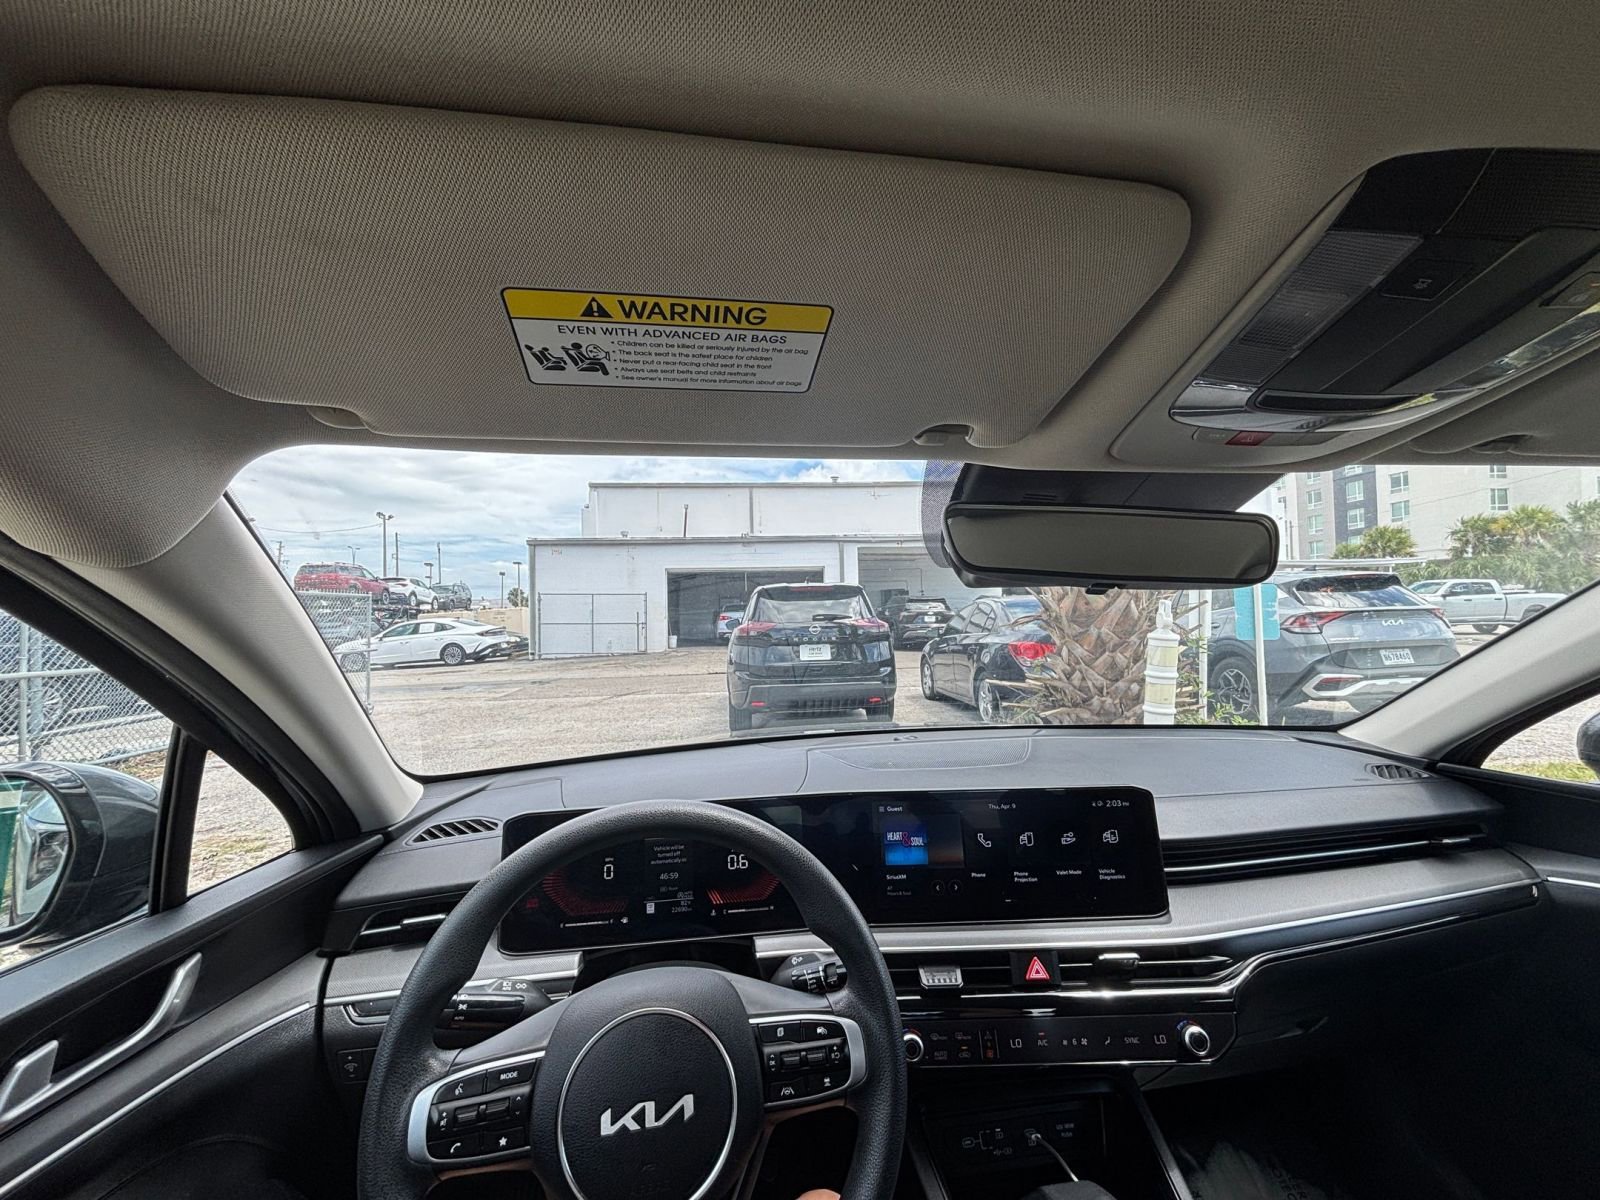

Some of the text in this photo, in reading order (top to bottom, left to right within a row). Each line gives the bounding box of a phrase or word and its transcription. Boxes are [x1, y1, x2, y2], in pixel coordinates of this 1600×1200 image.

[616, 299, 767, 326] WARNING
[557, 324, 788, 344] EVEN WITH ADVANCED AIR BAGS
[887, 831, 924, 846] HEART & SOUL
[727, 853, 749, 870] 0.6
[604, 864, 614, 880] 0
[500, 1071, 518, 1080] MODE
[600, 1094, 694, 1136] KIA
